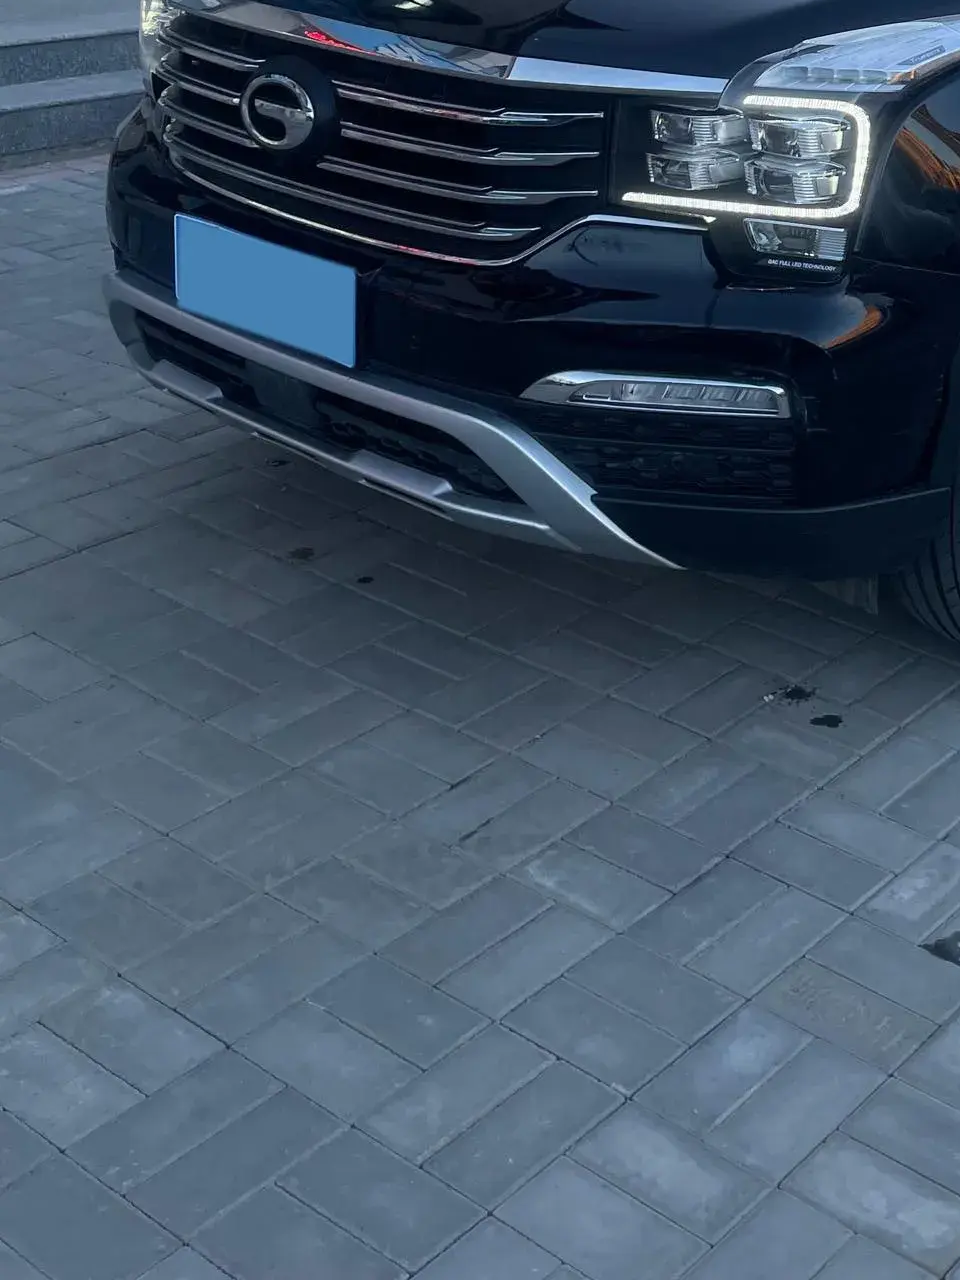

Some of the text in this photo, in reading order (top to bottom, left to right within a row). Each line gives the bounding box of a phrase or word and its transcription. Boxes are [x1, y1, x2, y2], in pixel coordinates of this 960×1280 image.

[779, 259, 791, 267] FULL
[791, 260, 802, 268] LED
[802, 262, 836, 271] TECHNOLOGY
